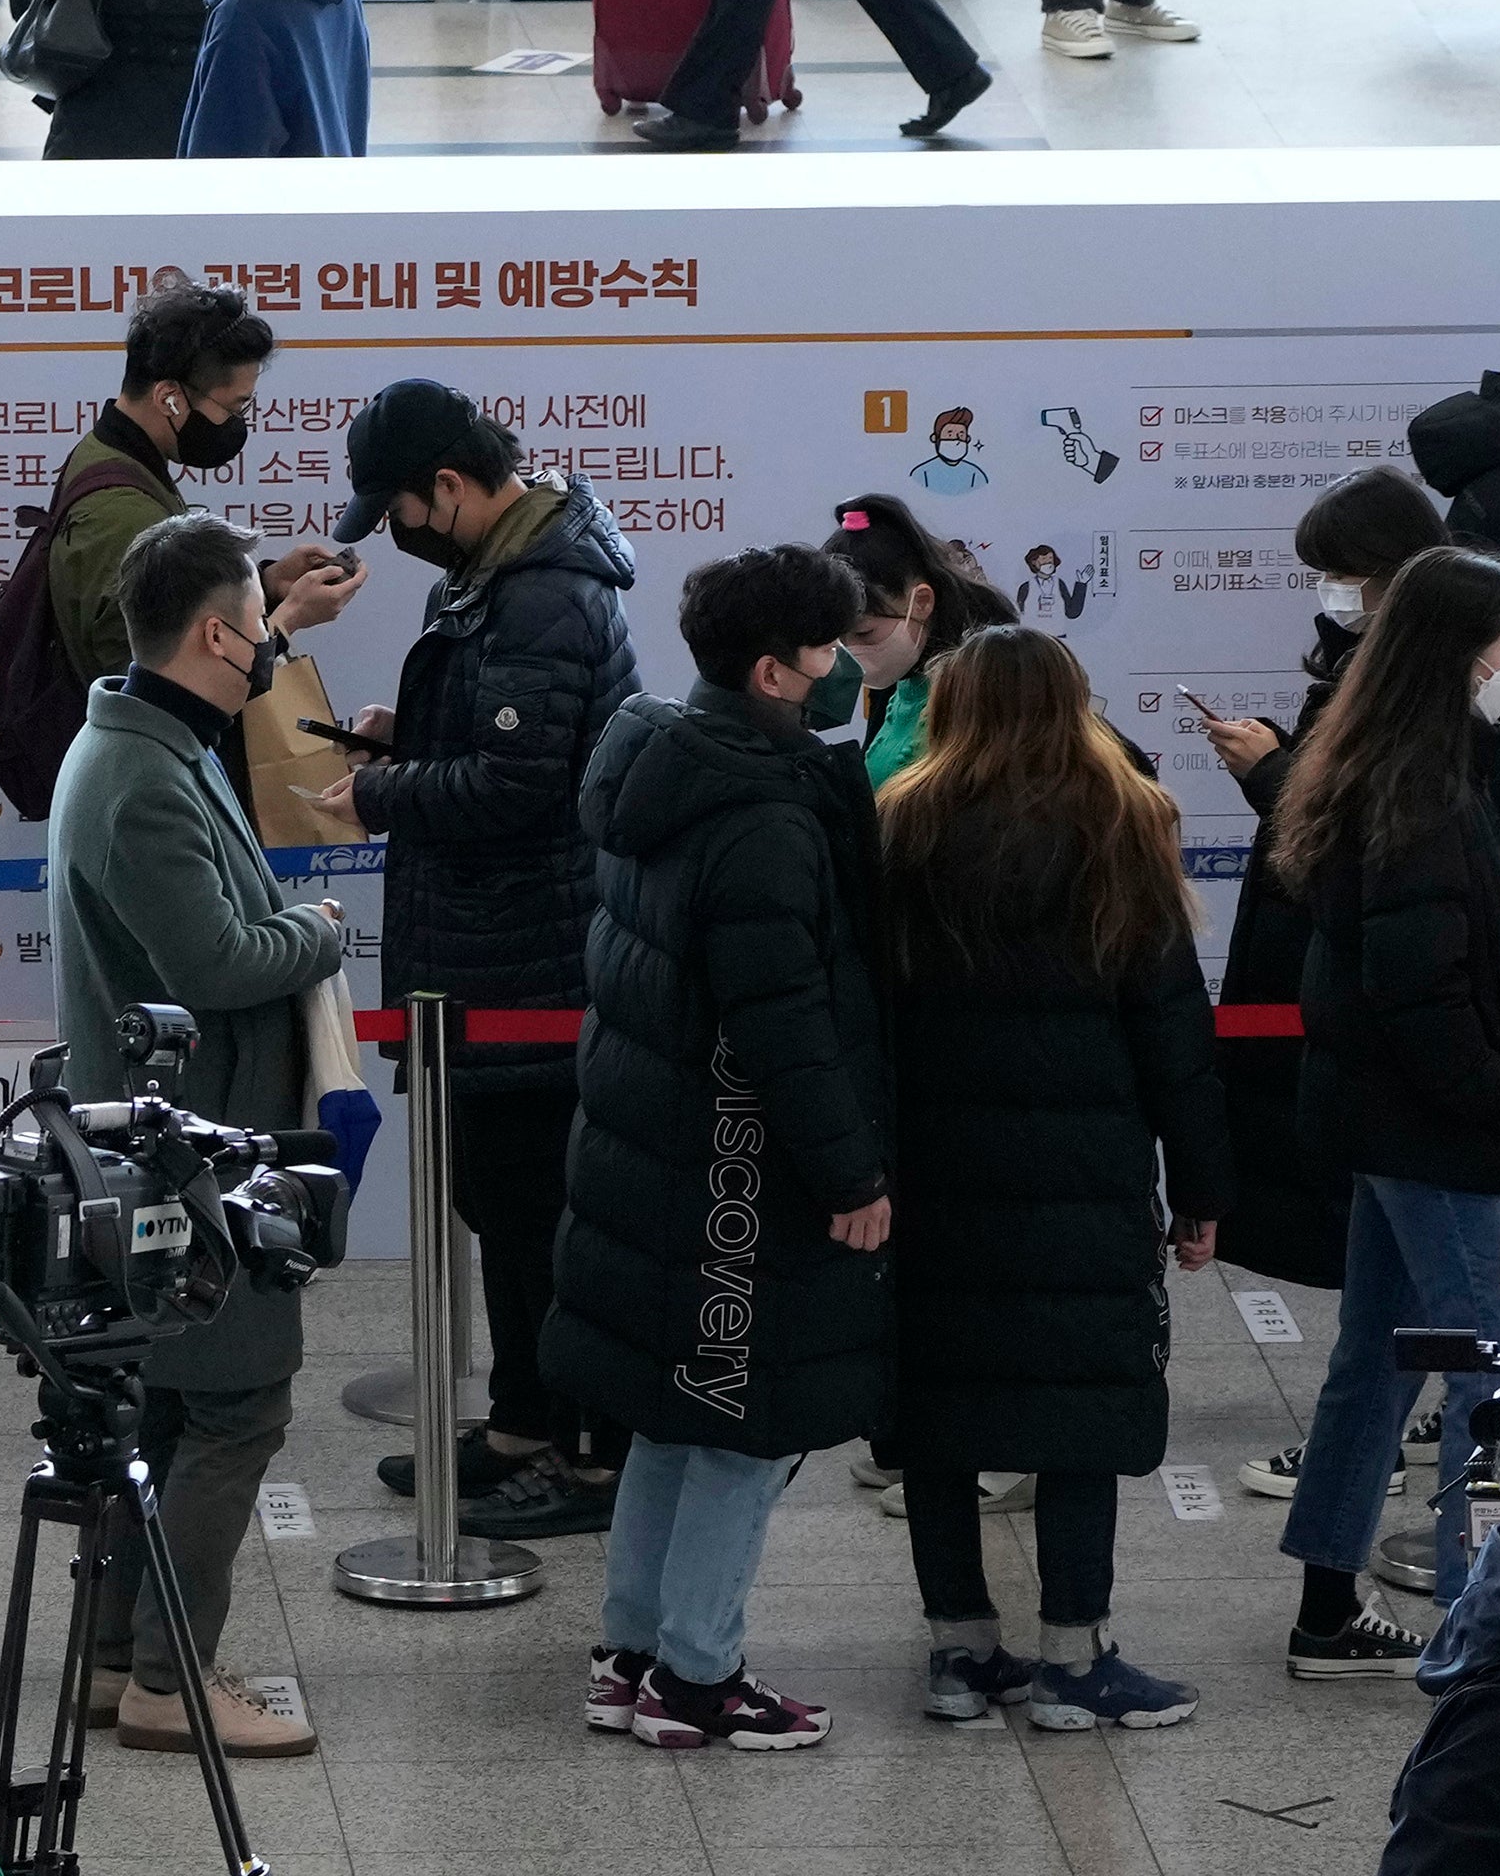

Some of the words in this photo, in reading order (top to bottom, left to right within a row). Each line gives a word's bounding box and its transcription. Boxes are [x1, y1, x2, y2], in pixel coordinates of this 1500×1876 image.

[317, 262, 418, 310] 안내
[435, 261, 481, 310] 및
[499, 258, 698, 309] 예방수칙
[538, 394, 647, 429] 사전에
[1174, 406, 1246, 425] 마스크를
[1251, 405, 1323, 425] 착용하여
[1328, 405, 1384, 423] 주시기
[1174, 443, 1246, 460] 투표소에
[1251, 441, 1341, 460] 입장하려는
[1346, 440, 1382, 458] 모든
[258, 450, 330, 484] 소독
[1192, 474, 1250, 490] 앞사람과
[611, 498, 726, 533] 조하여
[1098, 535, 1110, 589] 임시기표소
[1174, 551, 1213, 570] 이때,
[1216, 550, 1253, 568] 발열
[1258, 549, 1293, 568] 또는
[1173, 573, 1282, 592] 임시기표소로
[1231, 692, 1268, 710] 입구
[1173, 753, 1212, 772] 이때,
[157, 1217, 188, 1235] YTN
[259, 1686, 294, 1717] 거리두
